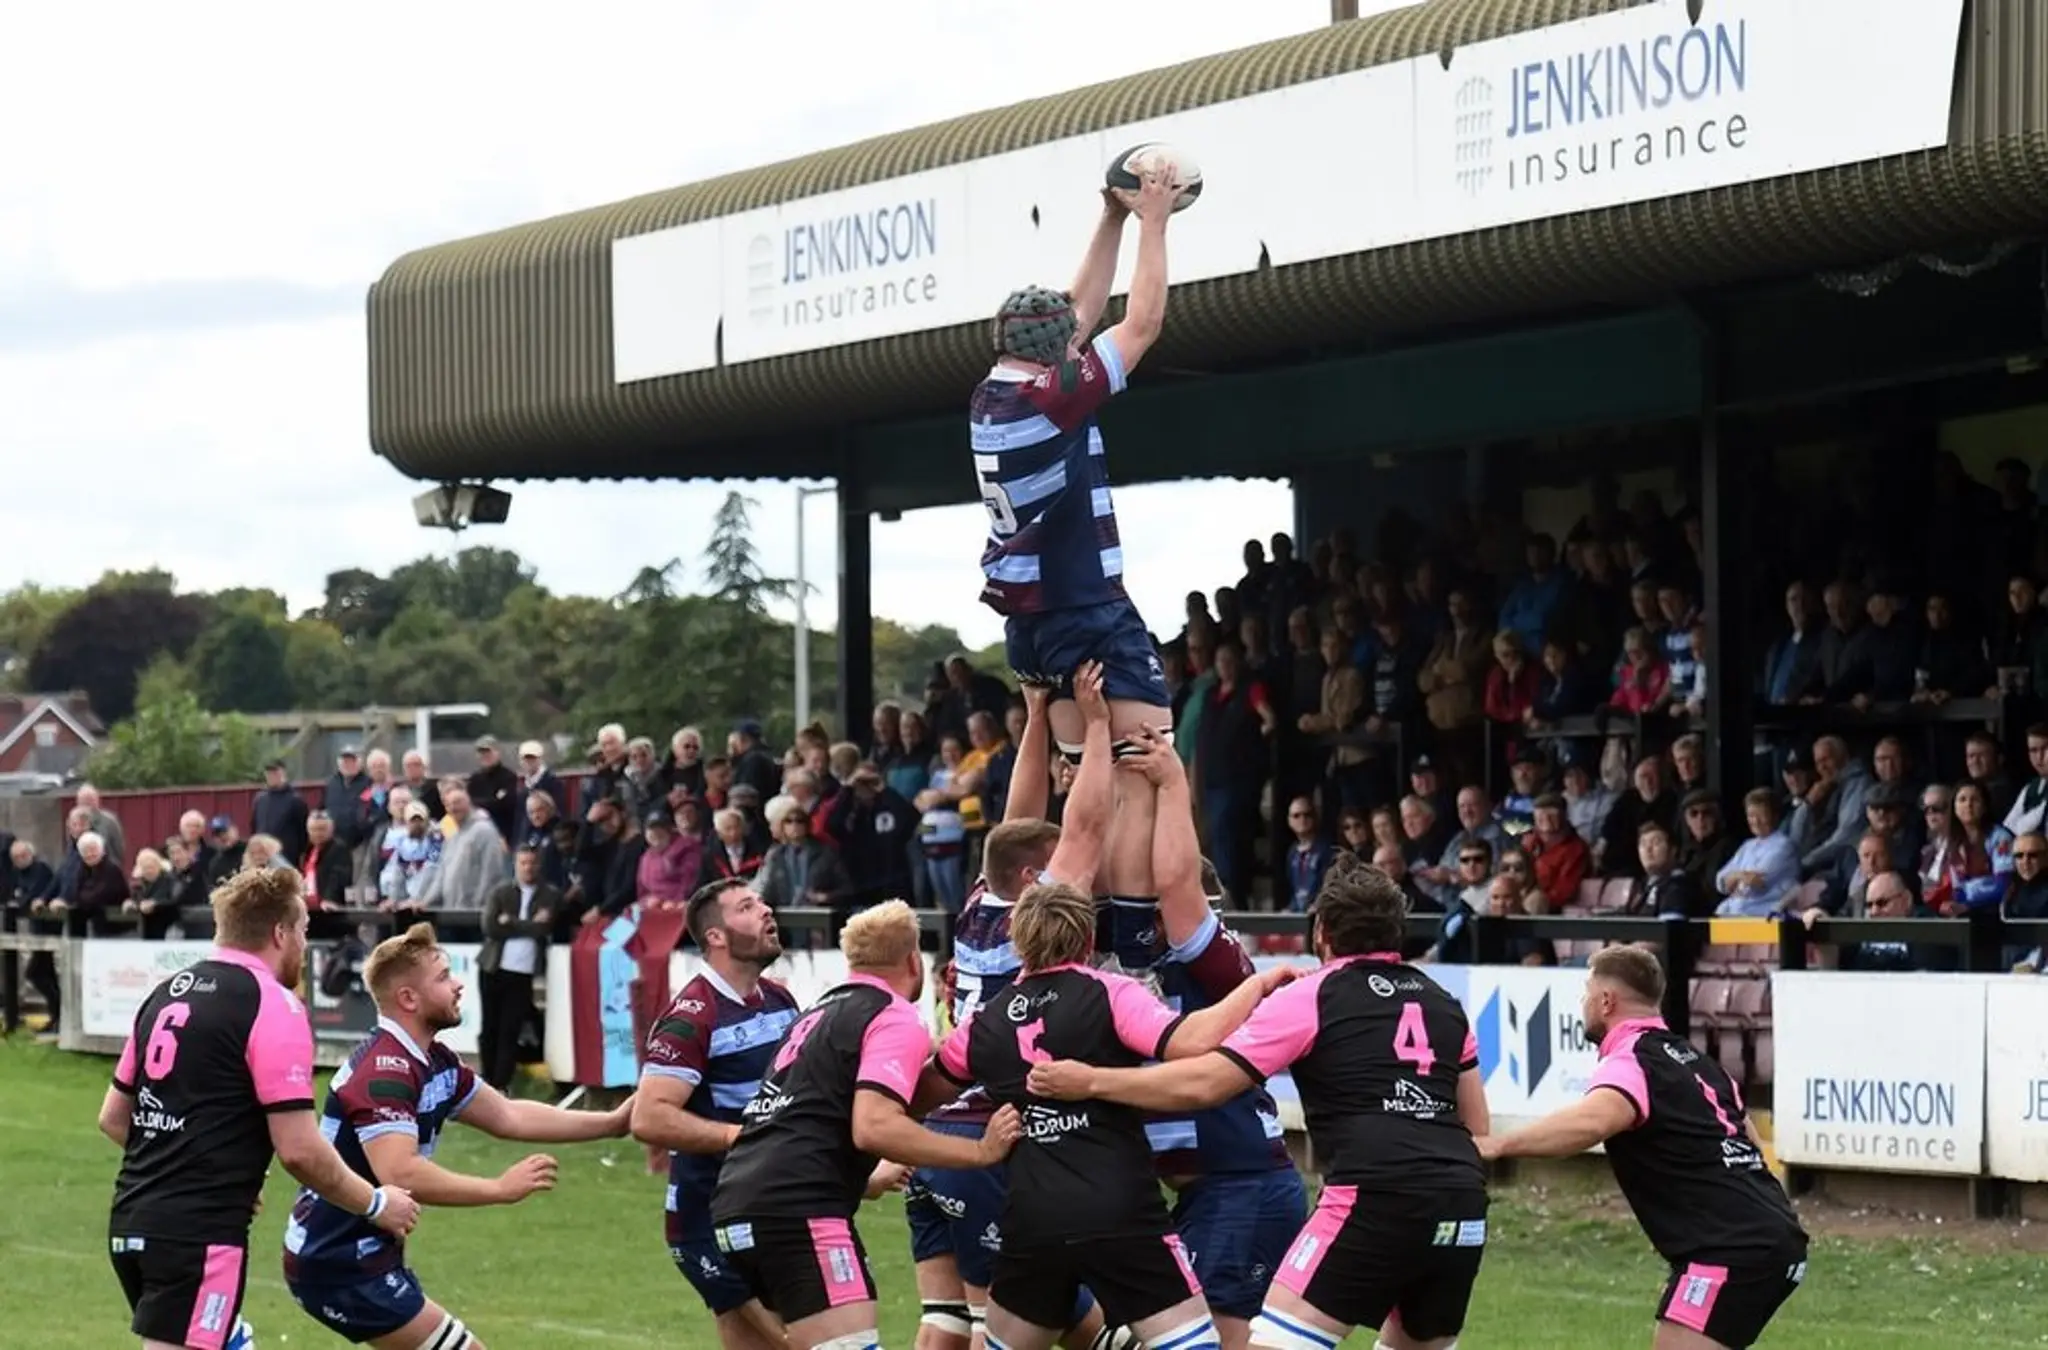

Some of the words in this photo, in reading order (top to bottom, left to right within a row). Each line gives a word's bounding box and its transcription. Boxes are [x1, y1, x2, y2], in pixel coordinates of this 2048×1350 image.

[1506, 19, 1747, 138] JENKINSON
[1508, 113, 1748, 190] insurance
[782, 198, 936, 286] JENKINSON
[783, 272, 937, 328] insurance
[974, 453, 1018, 535] 5
[144, 1001, 192, 1080] 6
[773, 1009, 826, 1073] 8
[1393, 1002, 1437, 1076] 4
[1803, 1079, 1954, 1127] JENKINSON
[1804, 1132, 1957, 1162] insurance
